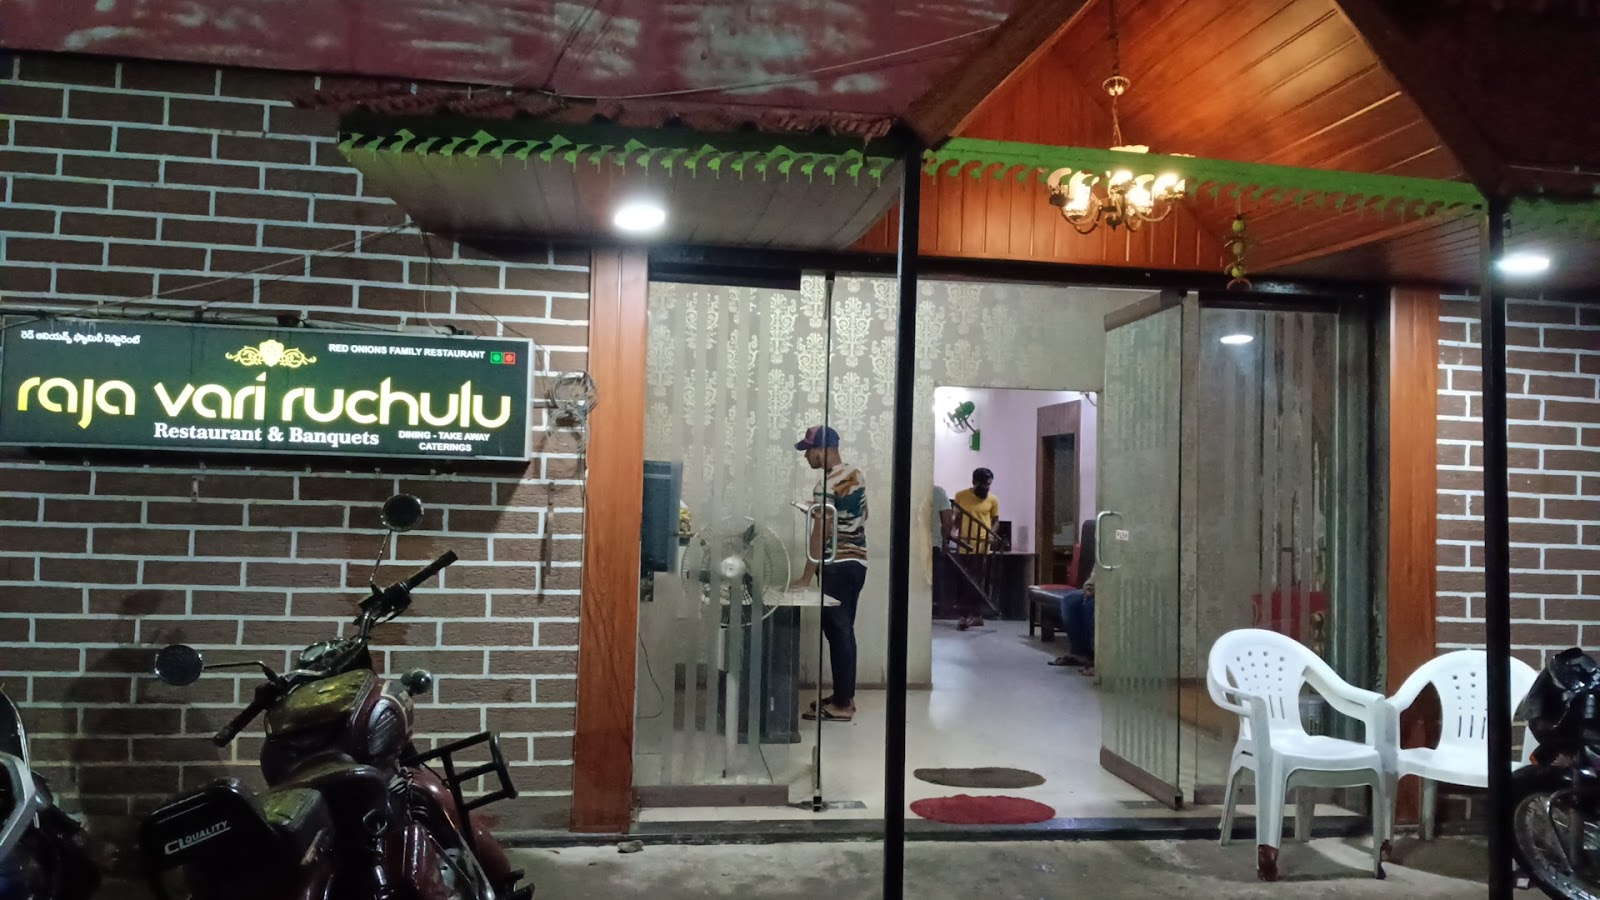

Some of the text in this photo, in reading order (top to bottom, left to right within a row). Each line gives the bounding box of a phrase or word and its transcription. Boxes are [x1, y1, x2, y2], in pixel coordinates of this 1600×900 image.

[328, 343, 485, 359] RED ONIONS FAMILY RESTAURANT
[17, 371, 511, 429] raja vari ruchulu
[153, 422, 380, 448] Restaurant & Banquets
[398, 430, 431, 440] DINING
[438, 431, 462, 440] TAKE
[464, 432, 490, 442] AWAY
[418, 442, 472, 452] CATERINGS
